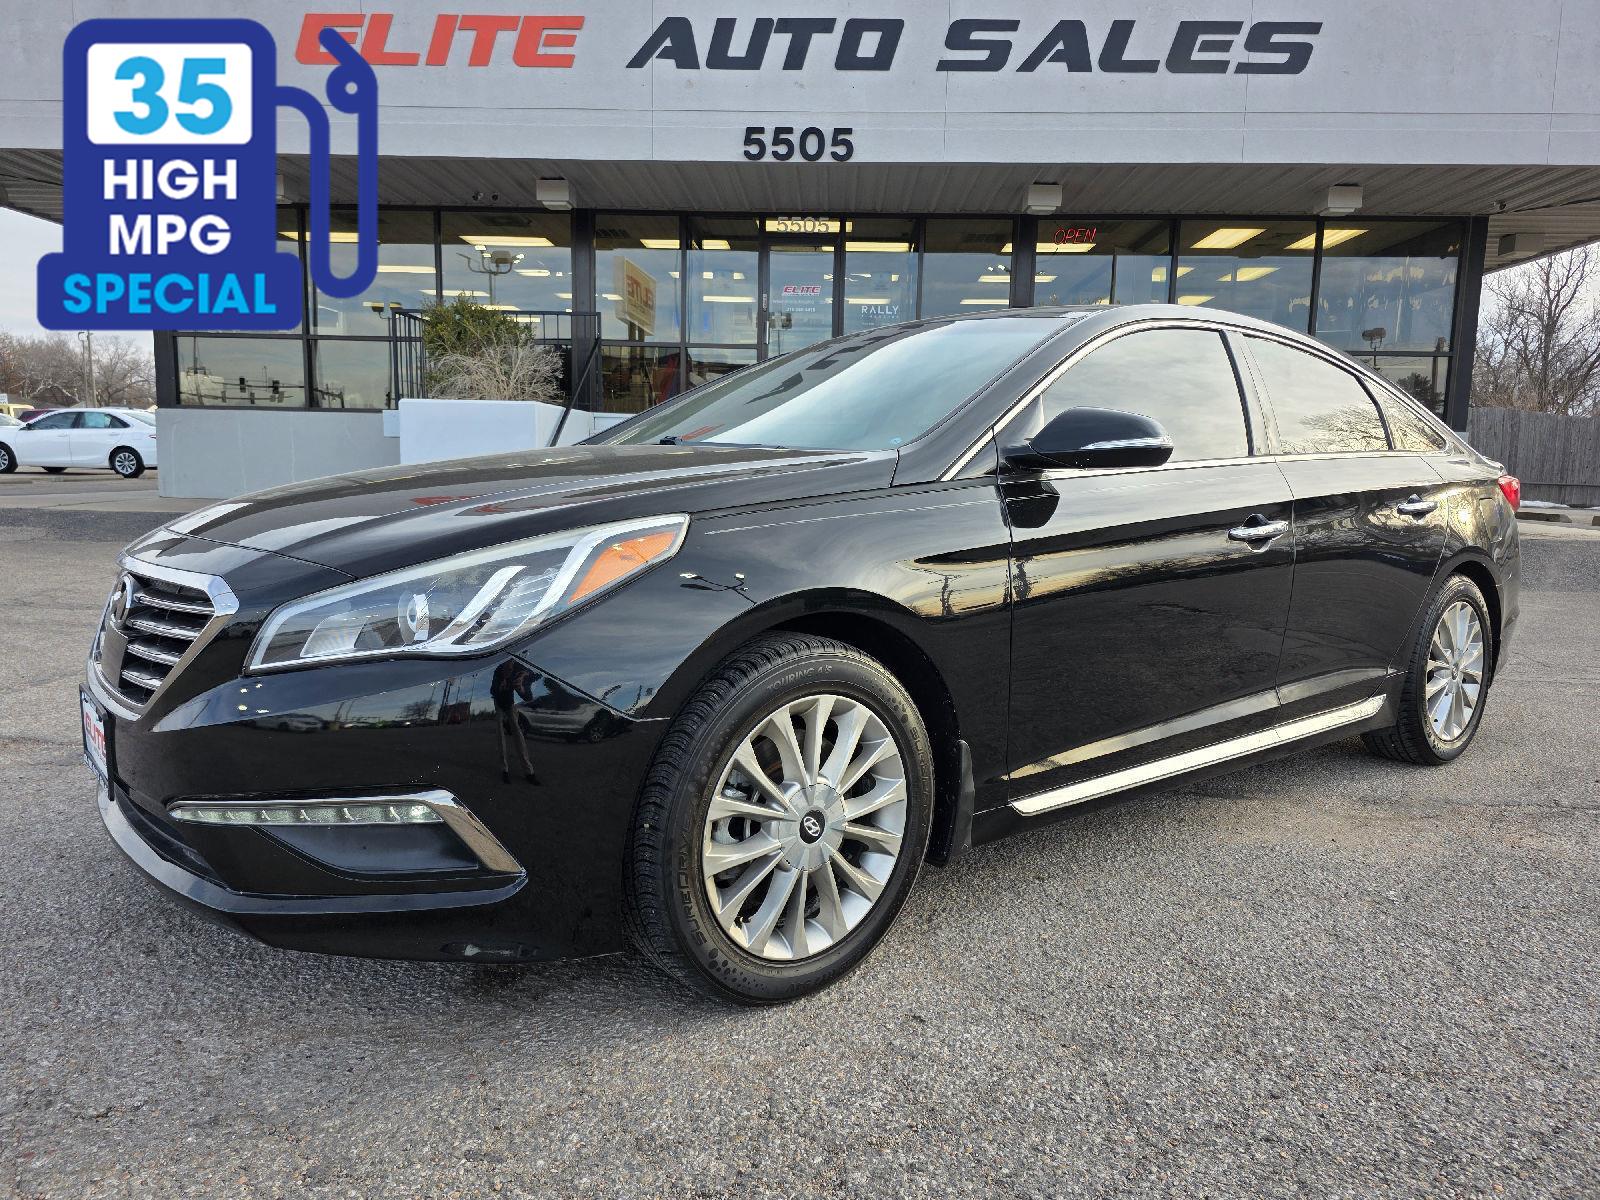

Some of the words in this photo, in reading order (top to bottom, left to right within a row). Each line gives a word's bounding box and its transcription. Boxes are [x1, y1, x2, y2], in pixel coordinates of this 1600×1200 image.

[296, 13, 584, 69] ELITE
[626, 17, 905, 72] AUTO
[936, 19, 1324, 75] SALES
[743, 126, 854, 161] 5505
[777, 216, 830, 233] 5505
[1054, 227, 1097, 245] OPEN
[783, 285, 821, 294] ELITE
[861, 305, 899, 314] RALLY
